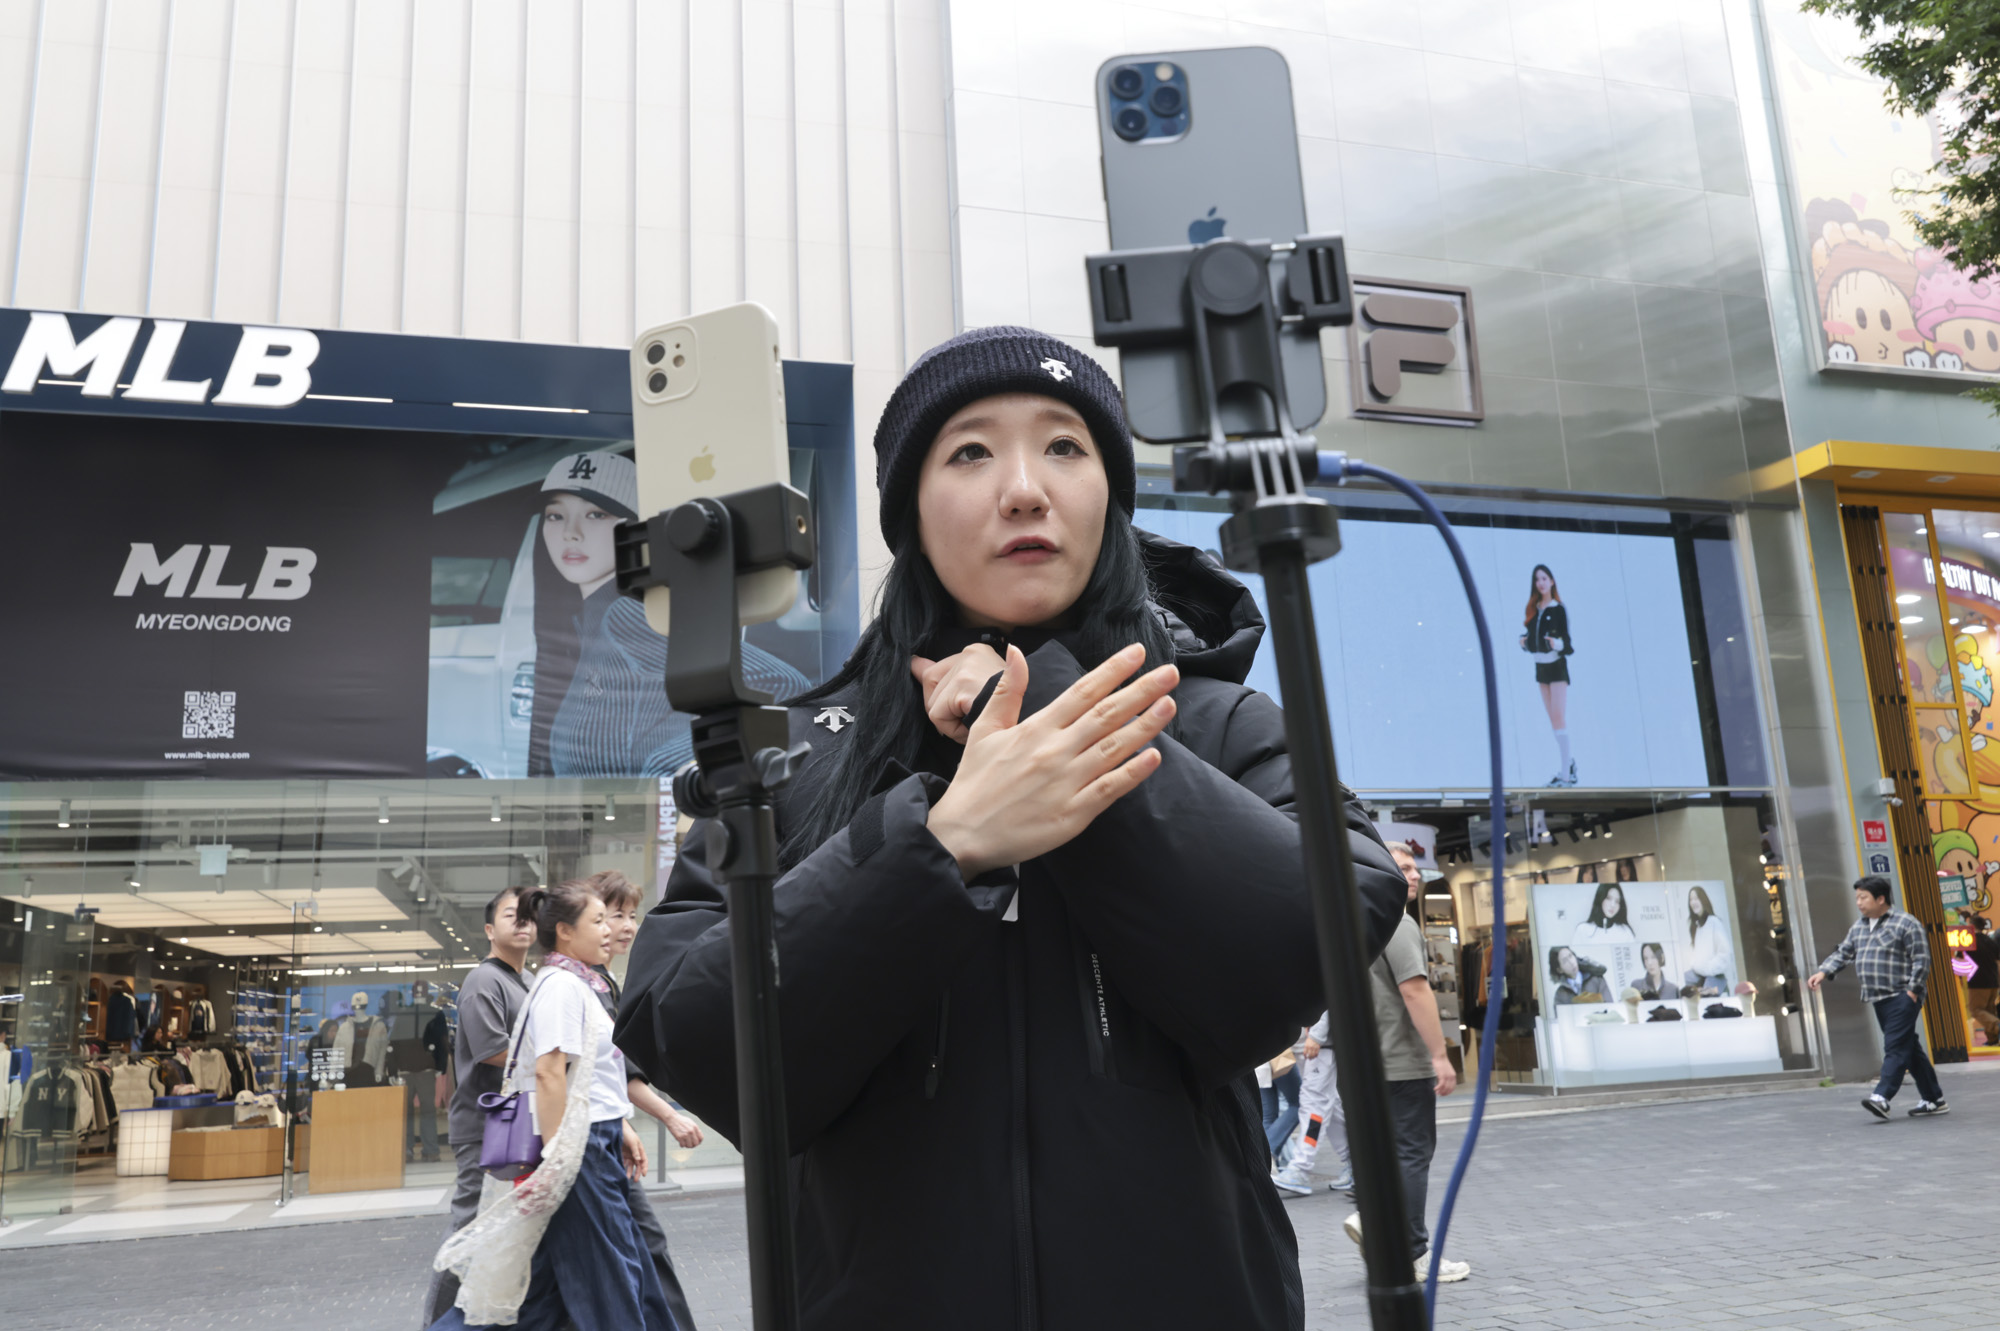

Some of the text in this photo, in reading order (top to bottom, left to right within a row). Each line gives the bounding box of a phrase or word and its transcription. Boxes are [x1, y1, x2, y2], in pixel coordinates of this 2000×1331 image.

[1, 312, 321, 409] MLB
[568, 454, 597, 480] LA
[113, 543, 317, 601] MLB
[1923, 557, 1972, 592] HALTHY
[135, 613, 292, 633] MYEONGDONG
[164, 751, 250, 759] www.mlb-korea.com
[1091, 953, 1109, 1037] DESCENTE ATHLETIC
